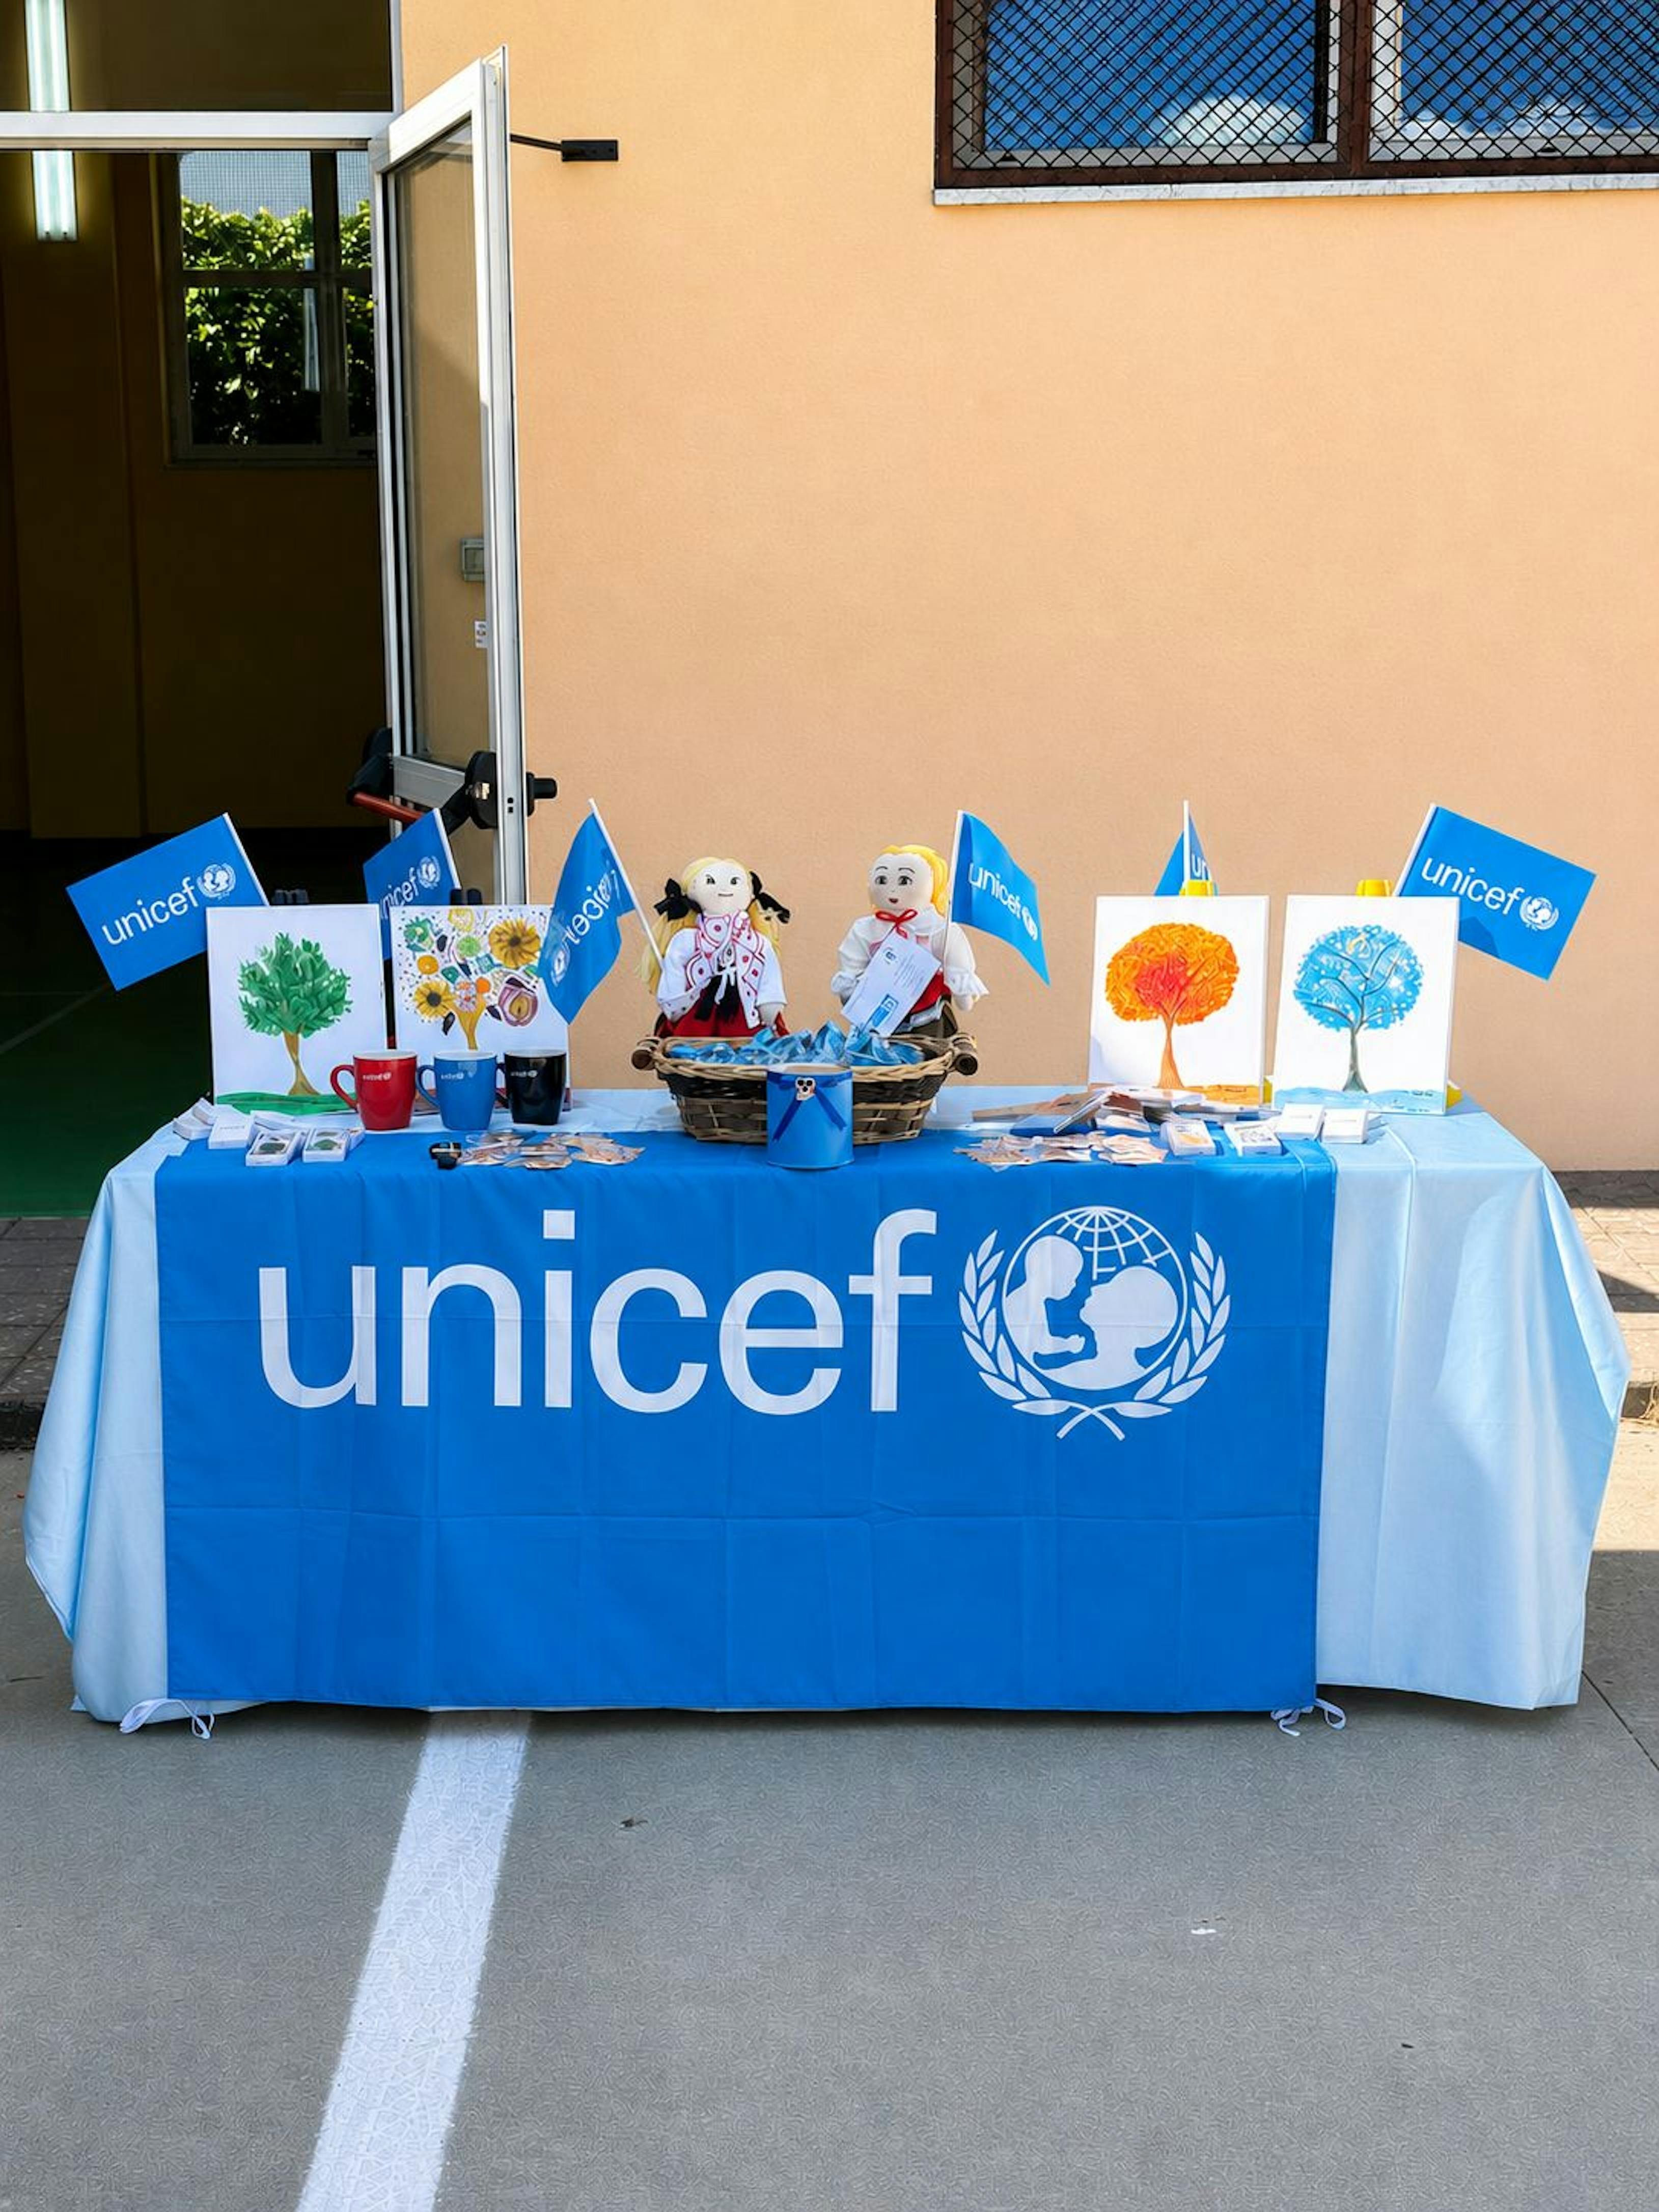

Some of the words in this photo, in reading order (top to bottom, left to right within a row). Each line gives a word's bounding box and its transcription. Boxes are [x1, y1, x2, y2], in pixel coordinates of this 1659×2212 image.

[101, 876, 199, 946] unicef
[380, 867, 419, 920] nicef
[1421, 857, 1525, 915] unicef
[259, 1208, 937, 1416] unicef
